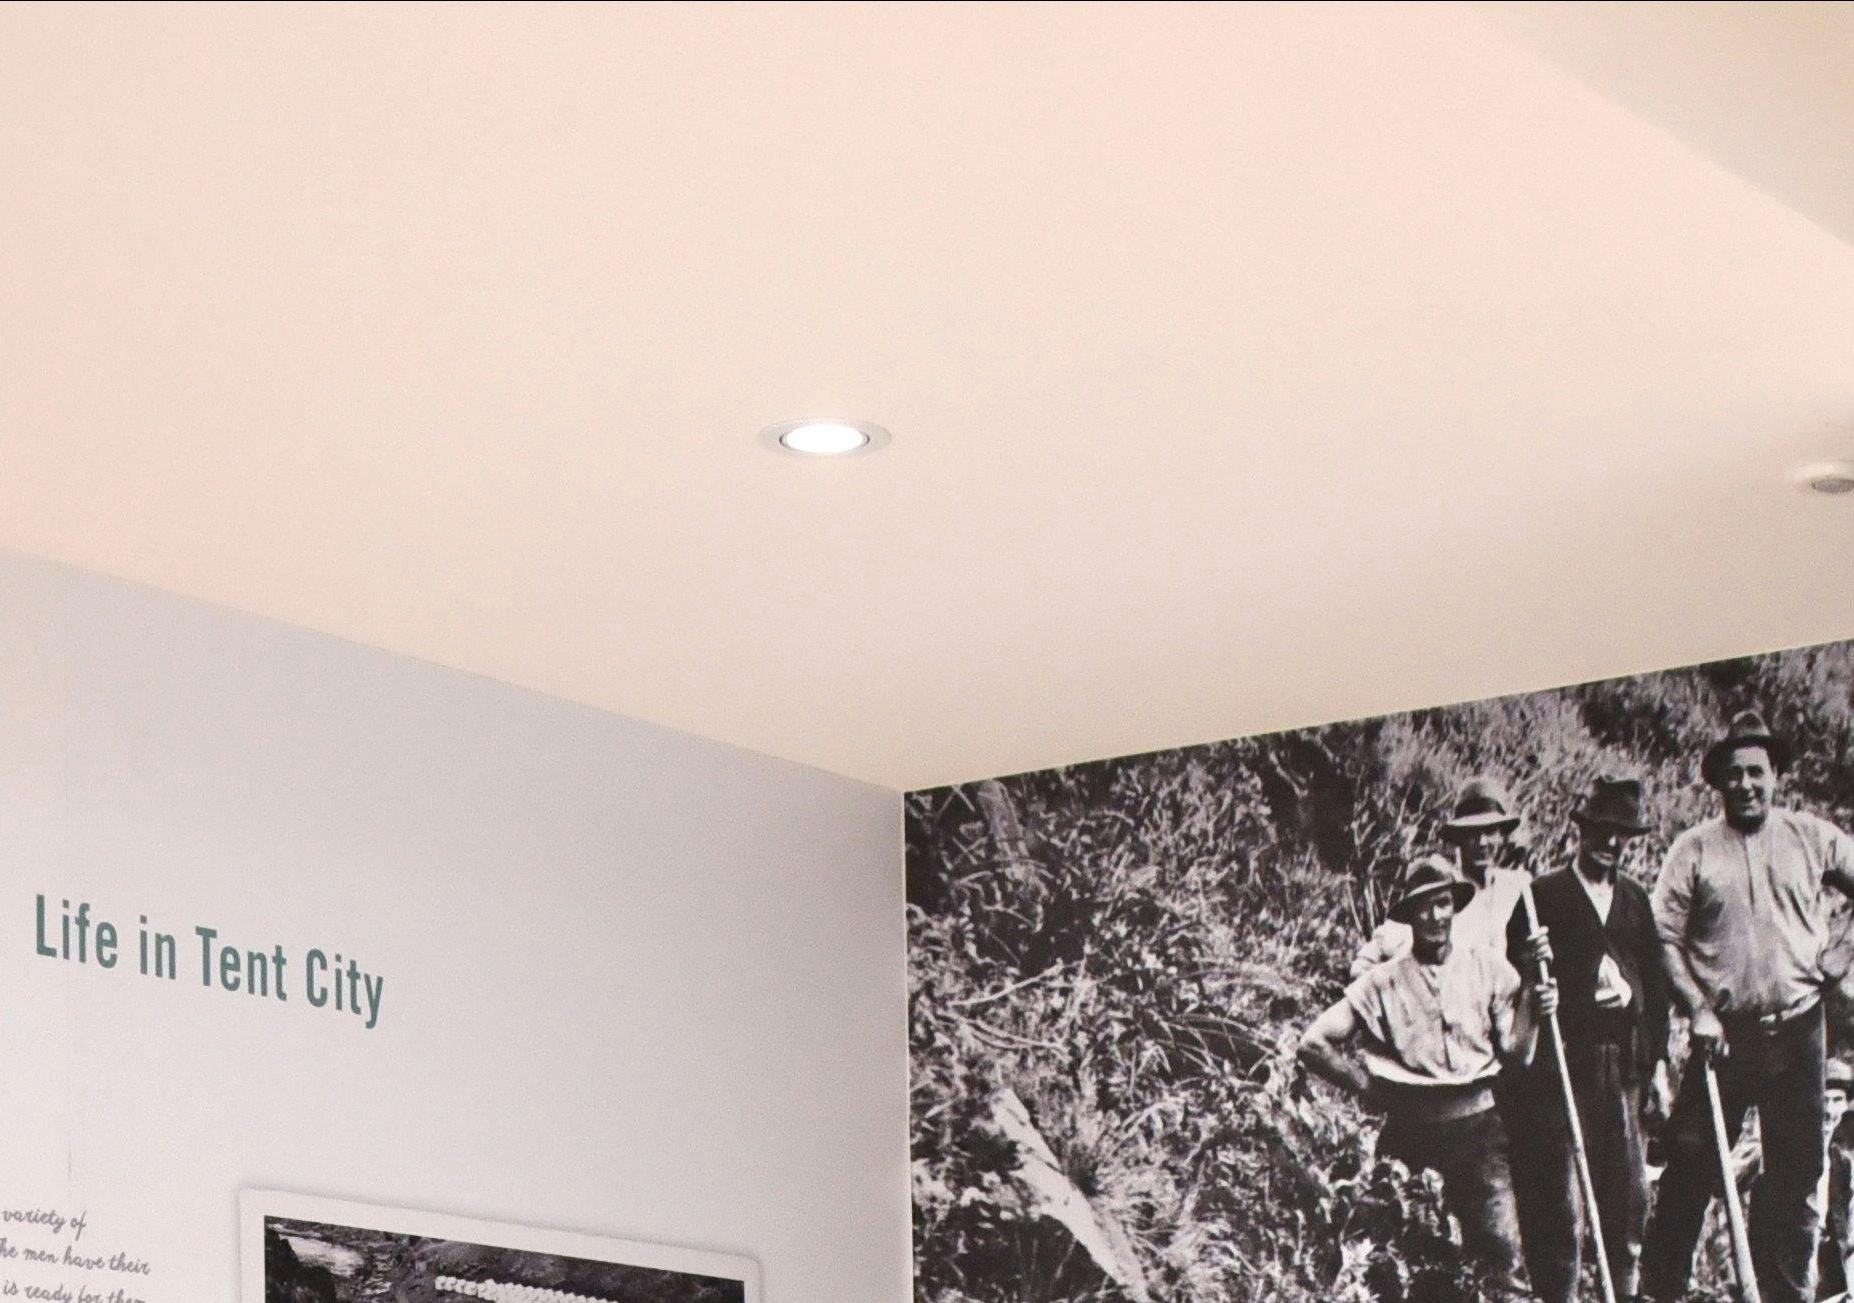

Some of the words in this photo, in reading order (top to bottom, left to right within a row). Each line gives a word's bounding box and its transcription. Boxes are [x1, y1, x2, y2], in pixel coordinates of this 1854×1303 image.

[36, 893, 118, 969] Life
[139, 915, 176, 980] in
[195, 926, 287, 1001] Tent
[306, 948, 384, 1030] City
[2, 1208, 67, 1234] variety
[70, 1210, 87, 1241] of
